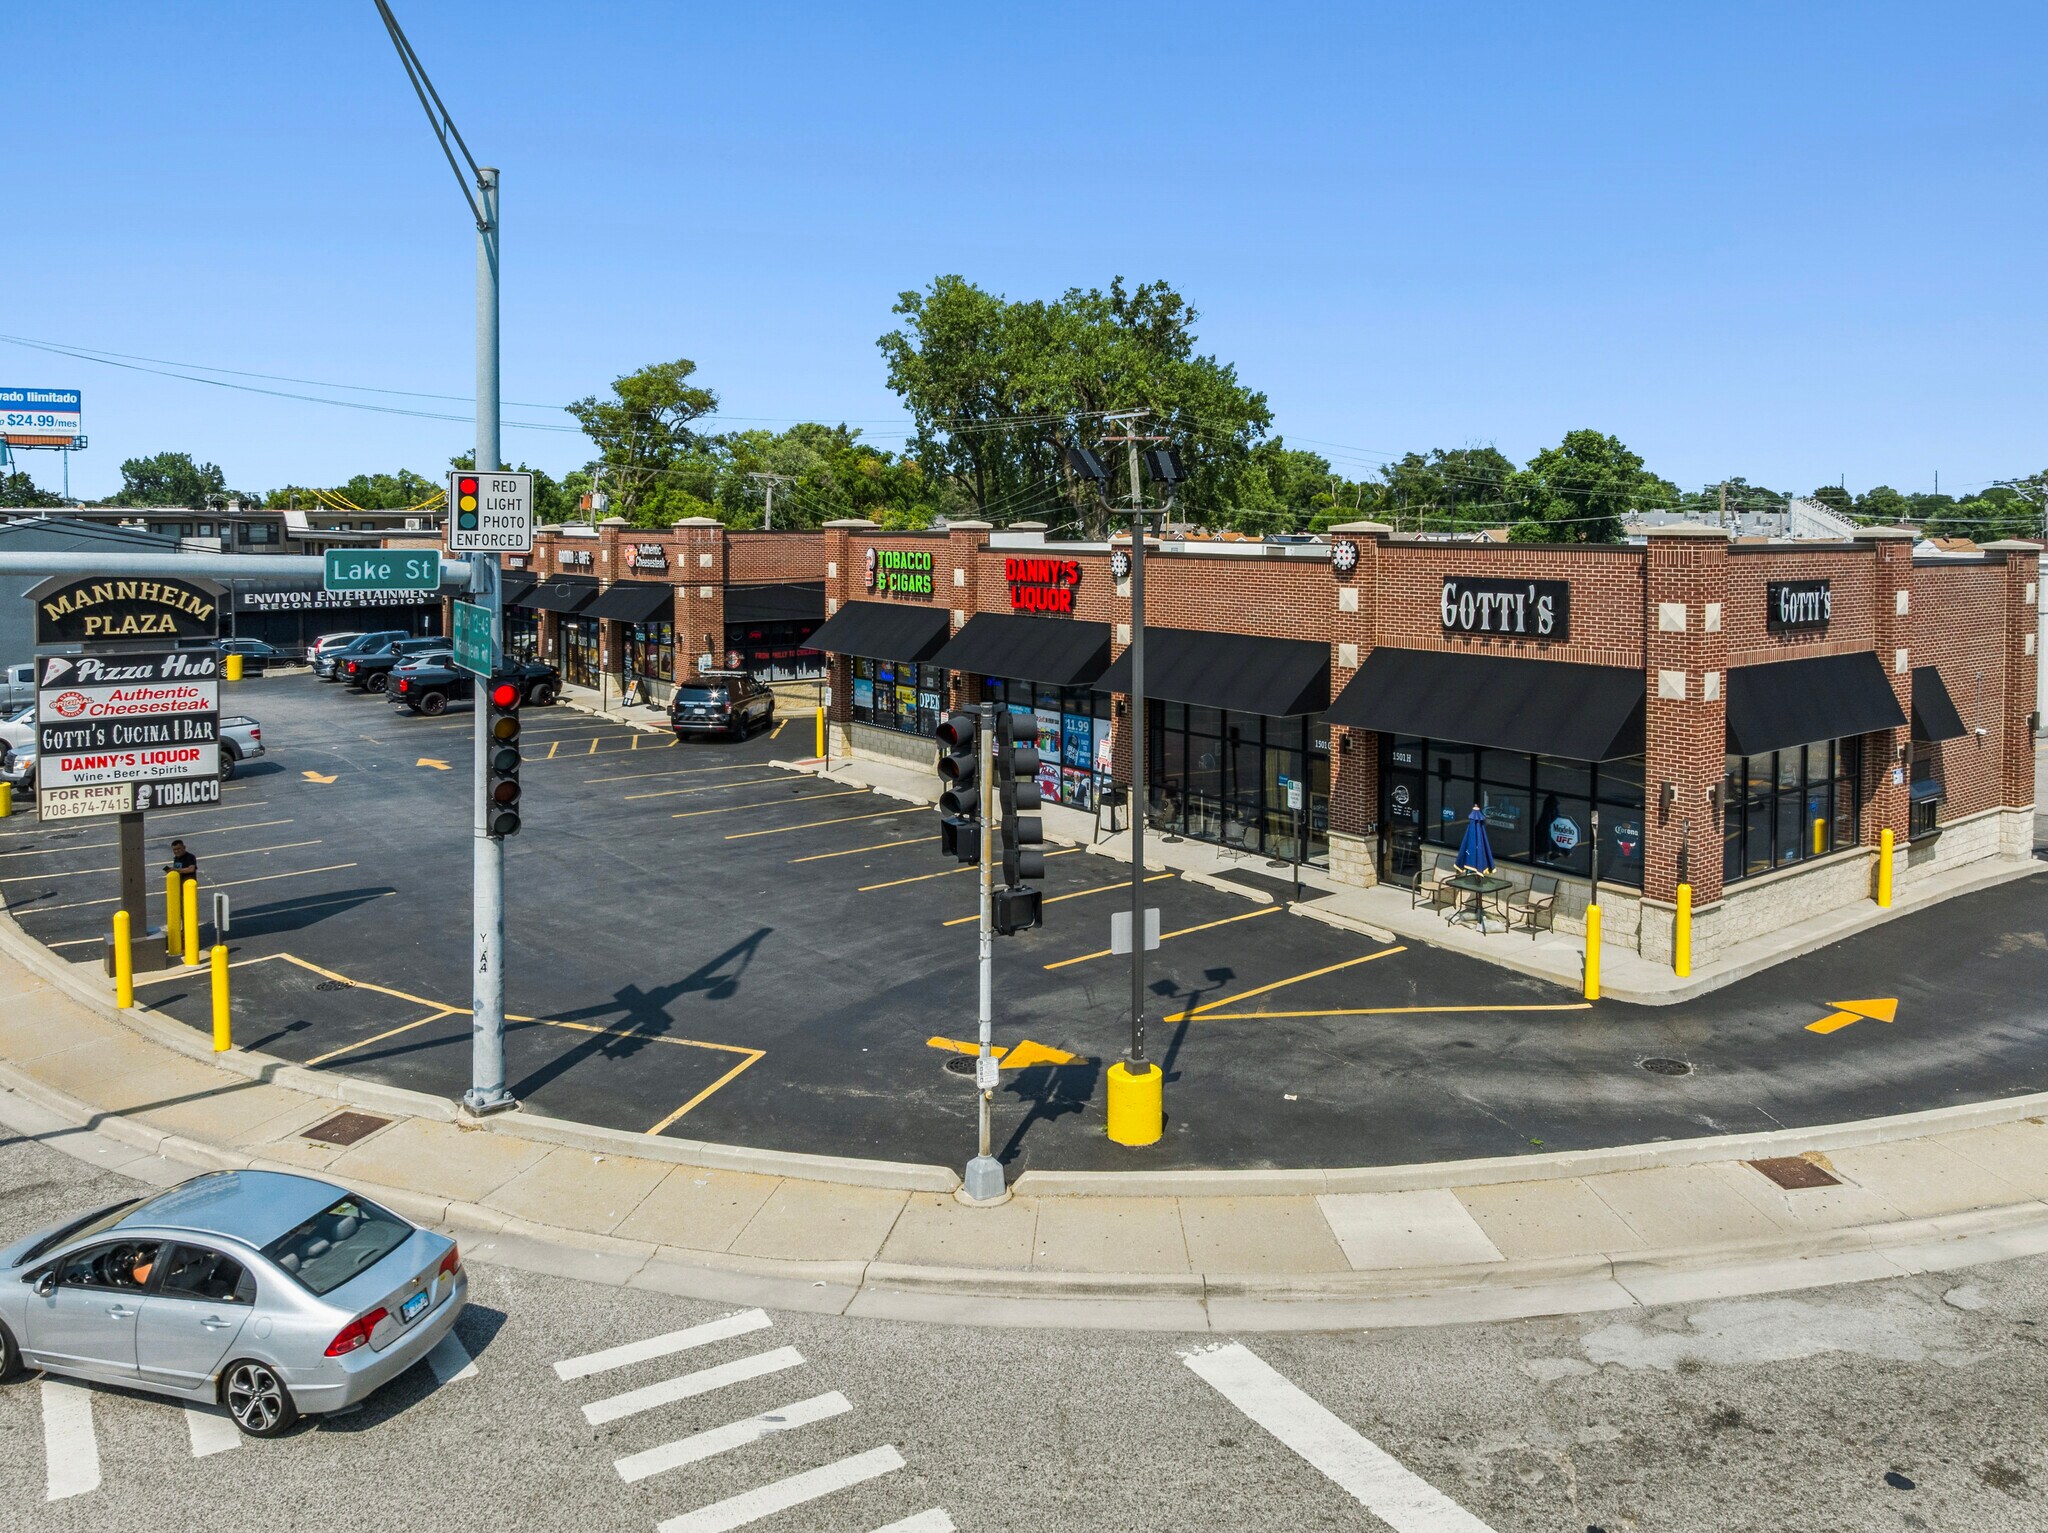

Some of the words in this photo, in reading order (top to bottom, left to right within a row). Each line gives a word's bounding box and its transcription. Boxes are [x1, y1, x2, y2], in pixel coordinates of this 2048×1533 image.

[27, 391, 77, 403] Ilimitado
[7, 413, 77, 428] $24.99/mes
[492, 480, 517, 493] RED
[487, 498, 522, 510] LIGHT
[483, 516, 525, 528] PHOTO
[457, 533, 523, 546] ENFORCED
[635, 556, 666, 568] Cheesesteak
[879, 551, 931, 570] TOBACCO
[334, 560, 391, 580] Lake
[405, 559, 431, 580] St
[1005, 558, 1079, 585] DANNY'S
[878, 573, 886, 590] &
[889, 574, 932, 593] CIGARS
[43, 581, 214, 622] MANNHEIM
[244, 591, 311, 604] ENVIYON
[260, 600, 352, 611] RECORDING
[359, 597, 425, 607] STUDIOS
[1011, 586, 1072, 612] LIQUOR
[84, 614, 178, 636] PLAZA
[76, 657, 154, 682] Pizza
[161, 654, 216, 679] Hub
[109, 686, 199, 703] Authentic
[920, 692, 940, 710] OPEN
[89, 698, 209, 717] Cheesesteak
[113, 724, 169, 744] CUCINA
[184, 719, 215, 740] BAR
[61, 752, 136, 772] DANNY'S
[141, 748, 200, 765] LIQUOR
[74, 772, 104, 783] Wine
[114, 770, 140, 779] Beer
[151, 766, 188, 777] Spirits
[50, 789, 80, 802] FOR
[84, 786, 124, 798] RENT
[155, 780, 219, 806] TOBACCO
[44, 797, 130, 817] 708-674-7415
[1614, 825, 1639, 837] Corona
[1556, 836, 1573, 845] UFC
